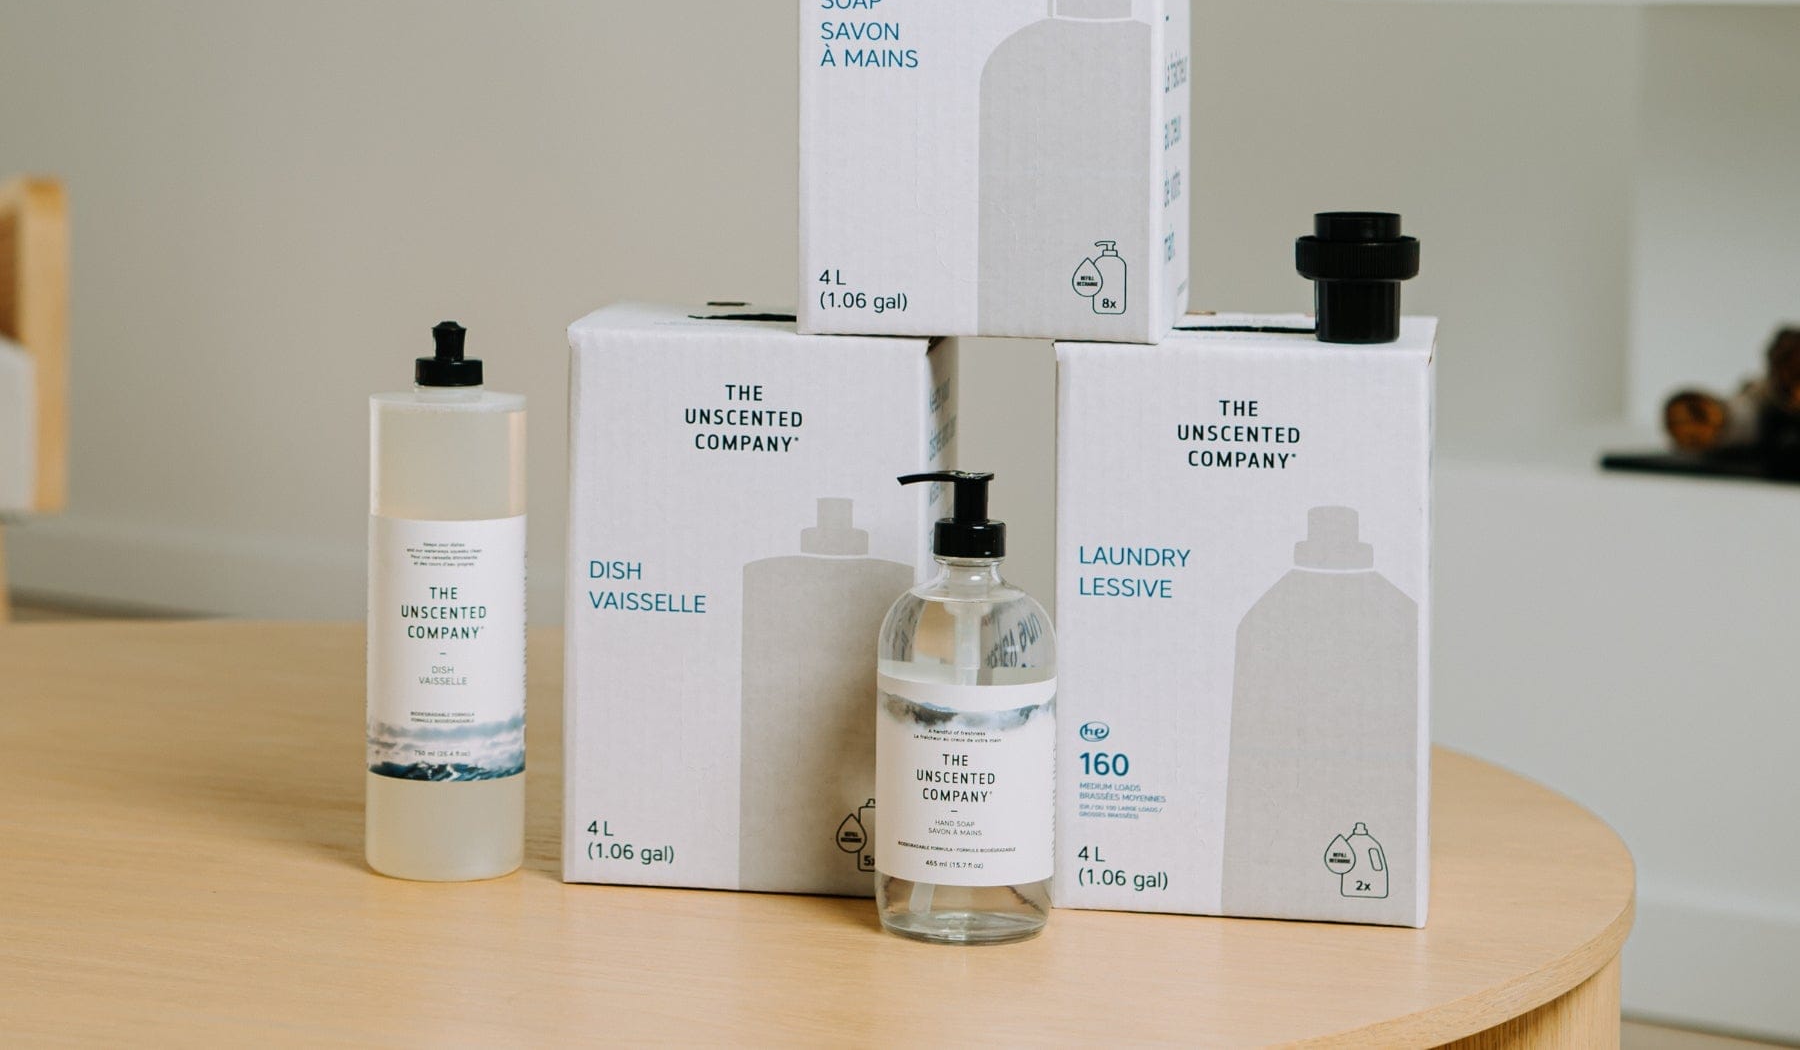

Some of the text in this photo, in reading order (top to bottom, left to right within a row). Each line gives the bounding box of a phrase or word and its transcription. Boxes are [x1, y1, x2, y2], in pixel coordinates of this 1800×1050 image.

[821, 22, 899, 41] SAVON
[821, 43, 919, 68] À MAINS
[819, 269, 847, 286] 4 L
[820, 291, 908, 314] (1.06 gal)
[1102, 298, 1117, 309] 8x
[725, 384, 763, 402] THE
[1218, 400, 1258, 417] THE
[685, 408, 803, 428] UNSCENTED
[1177, 424, 1301, 444] UNSCENTED
[1080, 545, 1191, 567] LAUNDRY
[590, 560, 642, 580] DISH
[430, 587, 458, 600] THE
[1080, 577, 1173, 599] LESSIVE
[589, 591, 706, 614] VAISSELLE
[401, 605, 487, 620] UNSCENTED
[431, 666, 455, 674] DISH
[418, 676, 468, 686] VAISSELLE
[1081, 722, 1109, 741] he
[942, 753, 969, 767] THE
[1079, 752, 1130, 777] 160
[916, 769, 996, 785] UNSCENTED
[1079, 782, 1141, 792] MEDIUM LOADS
[1122, 794, 1166, 803] MOYENNES
[587, 820, 614, 837] 4 L
[928, 827, 951, 835] SAVON
[960, 828, 982, 836] MAINS
[935, 819, 975, 828] HAND SOAP
[588, 842, 675, 865] (1.06 gal)
[1078, 846, 1106, 862] 4 L
[1078, 867, 1169, 892] (1.06 gal)
[1355, 880, 1371, 891] 2x
